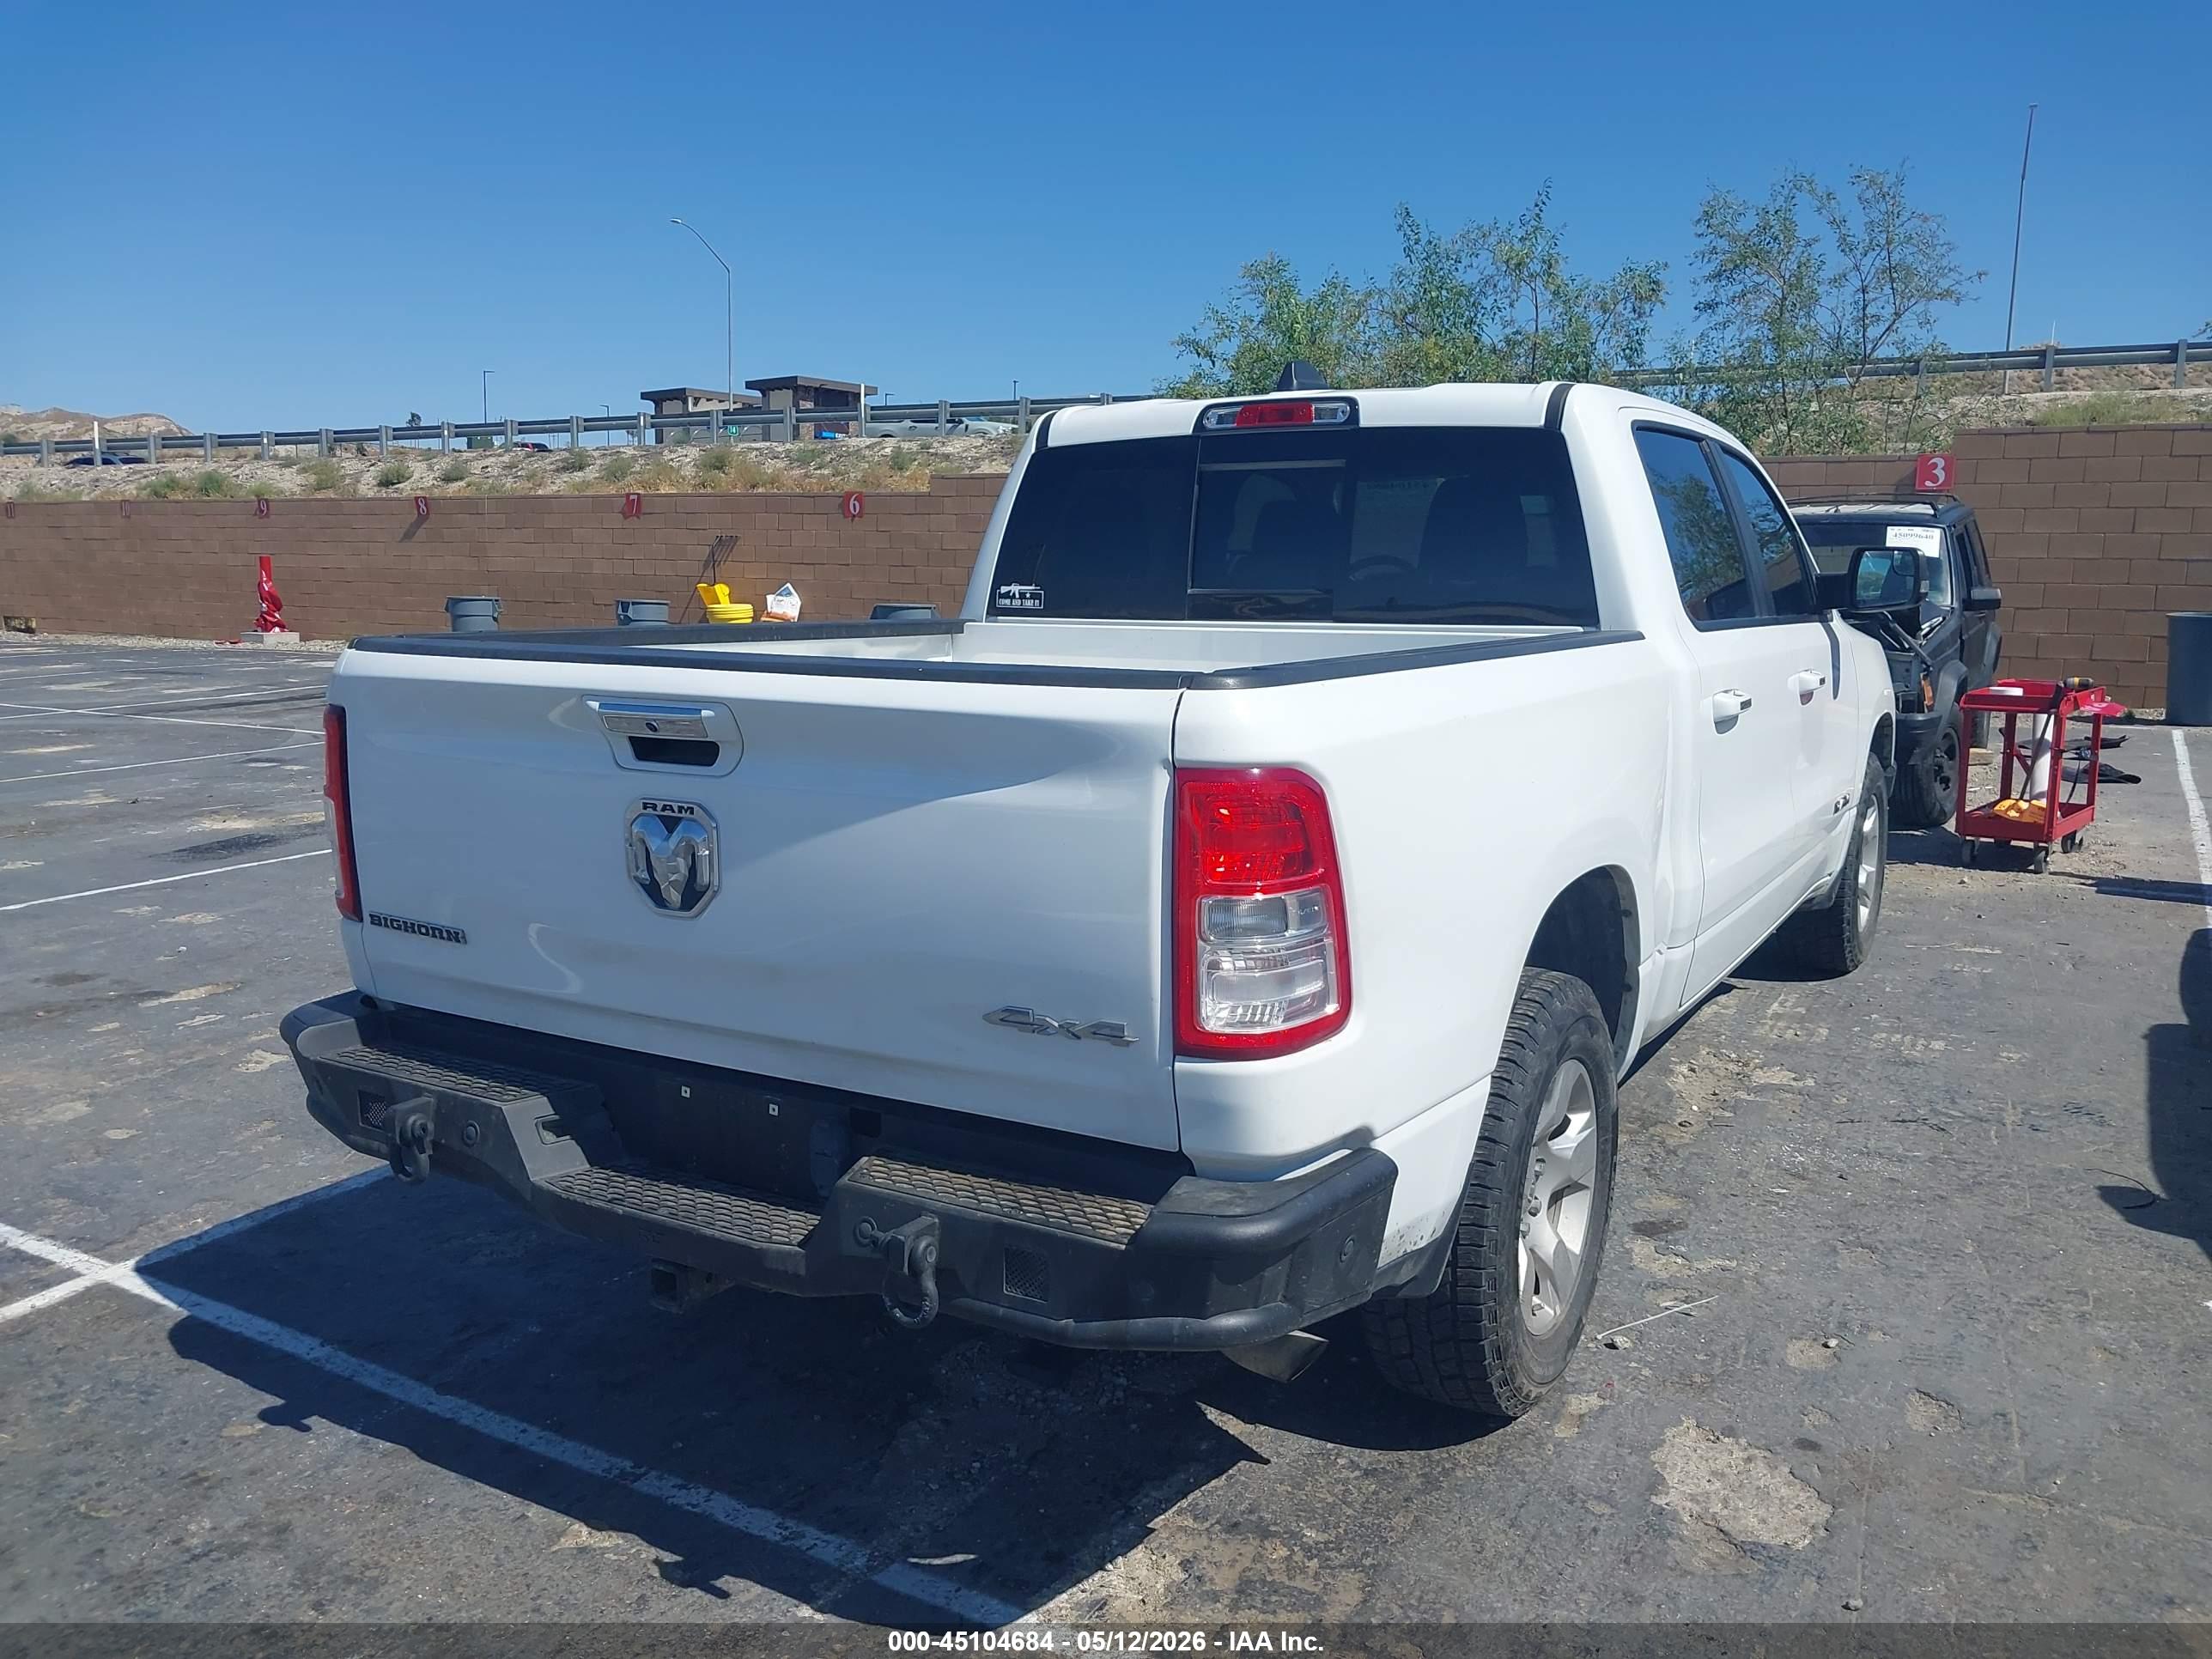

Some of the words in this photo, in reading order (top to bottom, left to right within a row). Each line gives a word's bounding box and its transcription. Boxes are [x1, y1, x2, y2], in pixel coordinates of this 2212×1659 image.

[1923, 456, 1946, 487] 3
[260, 500, 267, 516] 9
[418, 497, 427, 515] 8
[629, 494, 638, 515] 7
[849, 493, 860, 515] 6
[641, 801, 695, 815] RAM
[368, 913, 462, 944] BIGHORN
